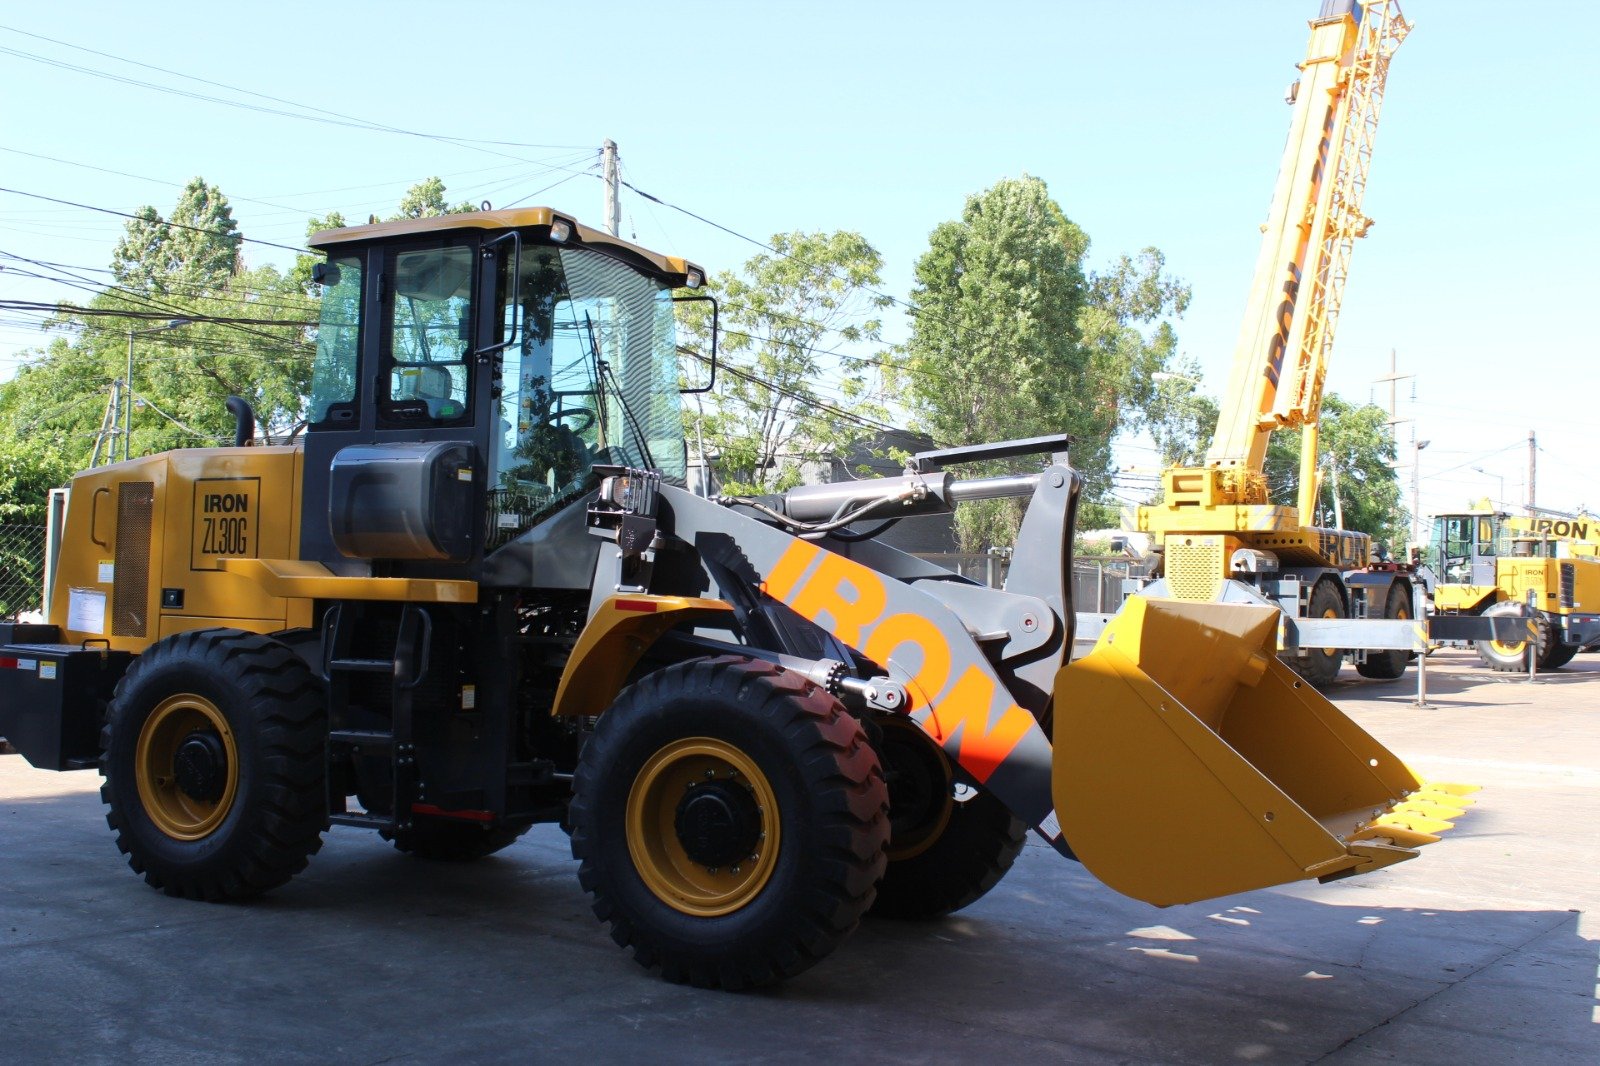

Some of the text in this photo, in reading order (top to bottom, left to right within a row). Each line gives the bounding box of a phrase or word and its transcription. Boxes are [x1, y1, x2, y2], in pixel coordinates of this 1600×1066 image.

[204, 493, 248, 513] IRON
[202, 517, 248, 555] ZL30G
[1530, 519, 1588, 540] IRON
[759, 537, 1035, 784] IRON
